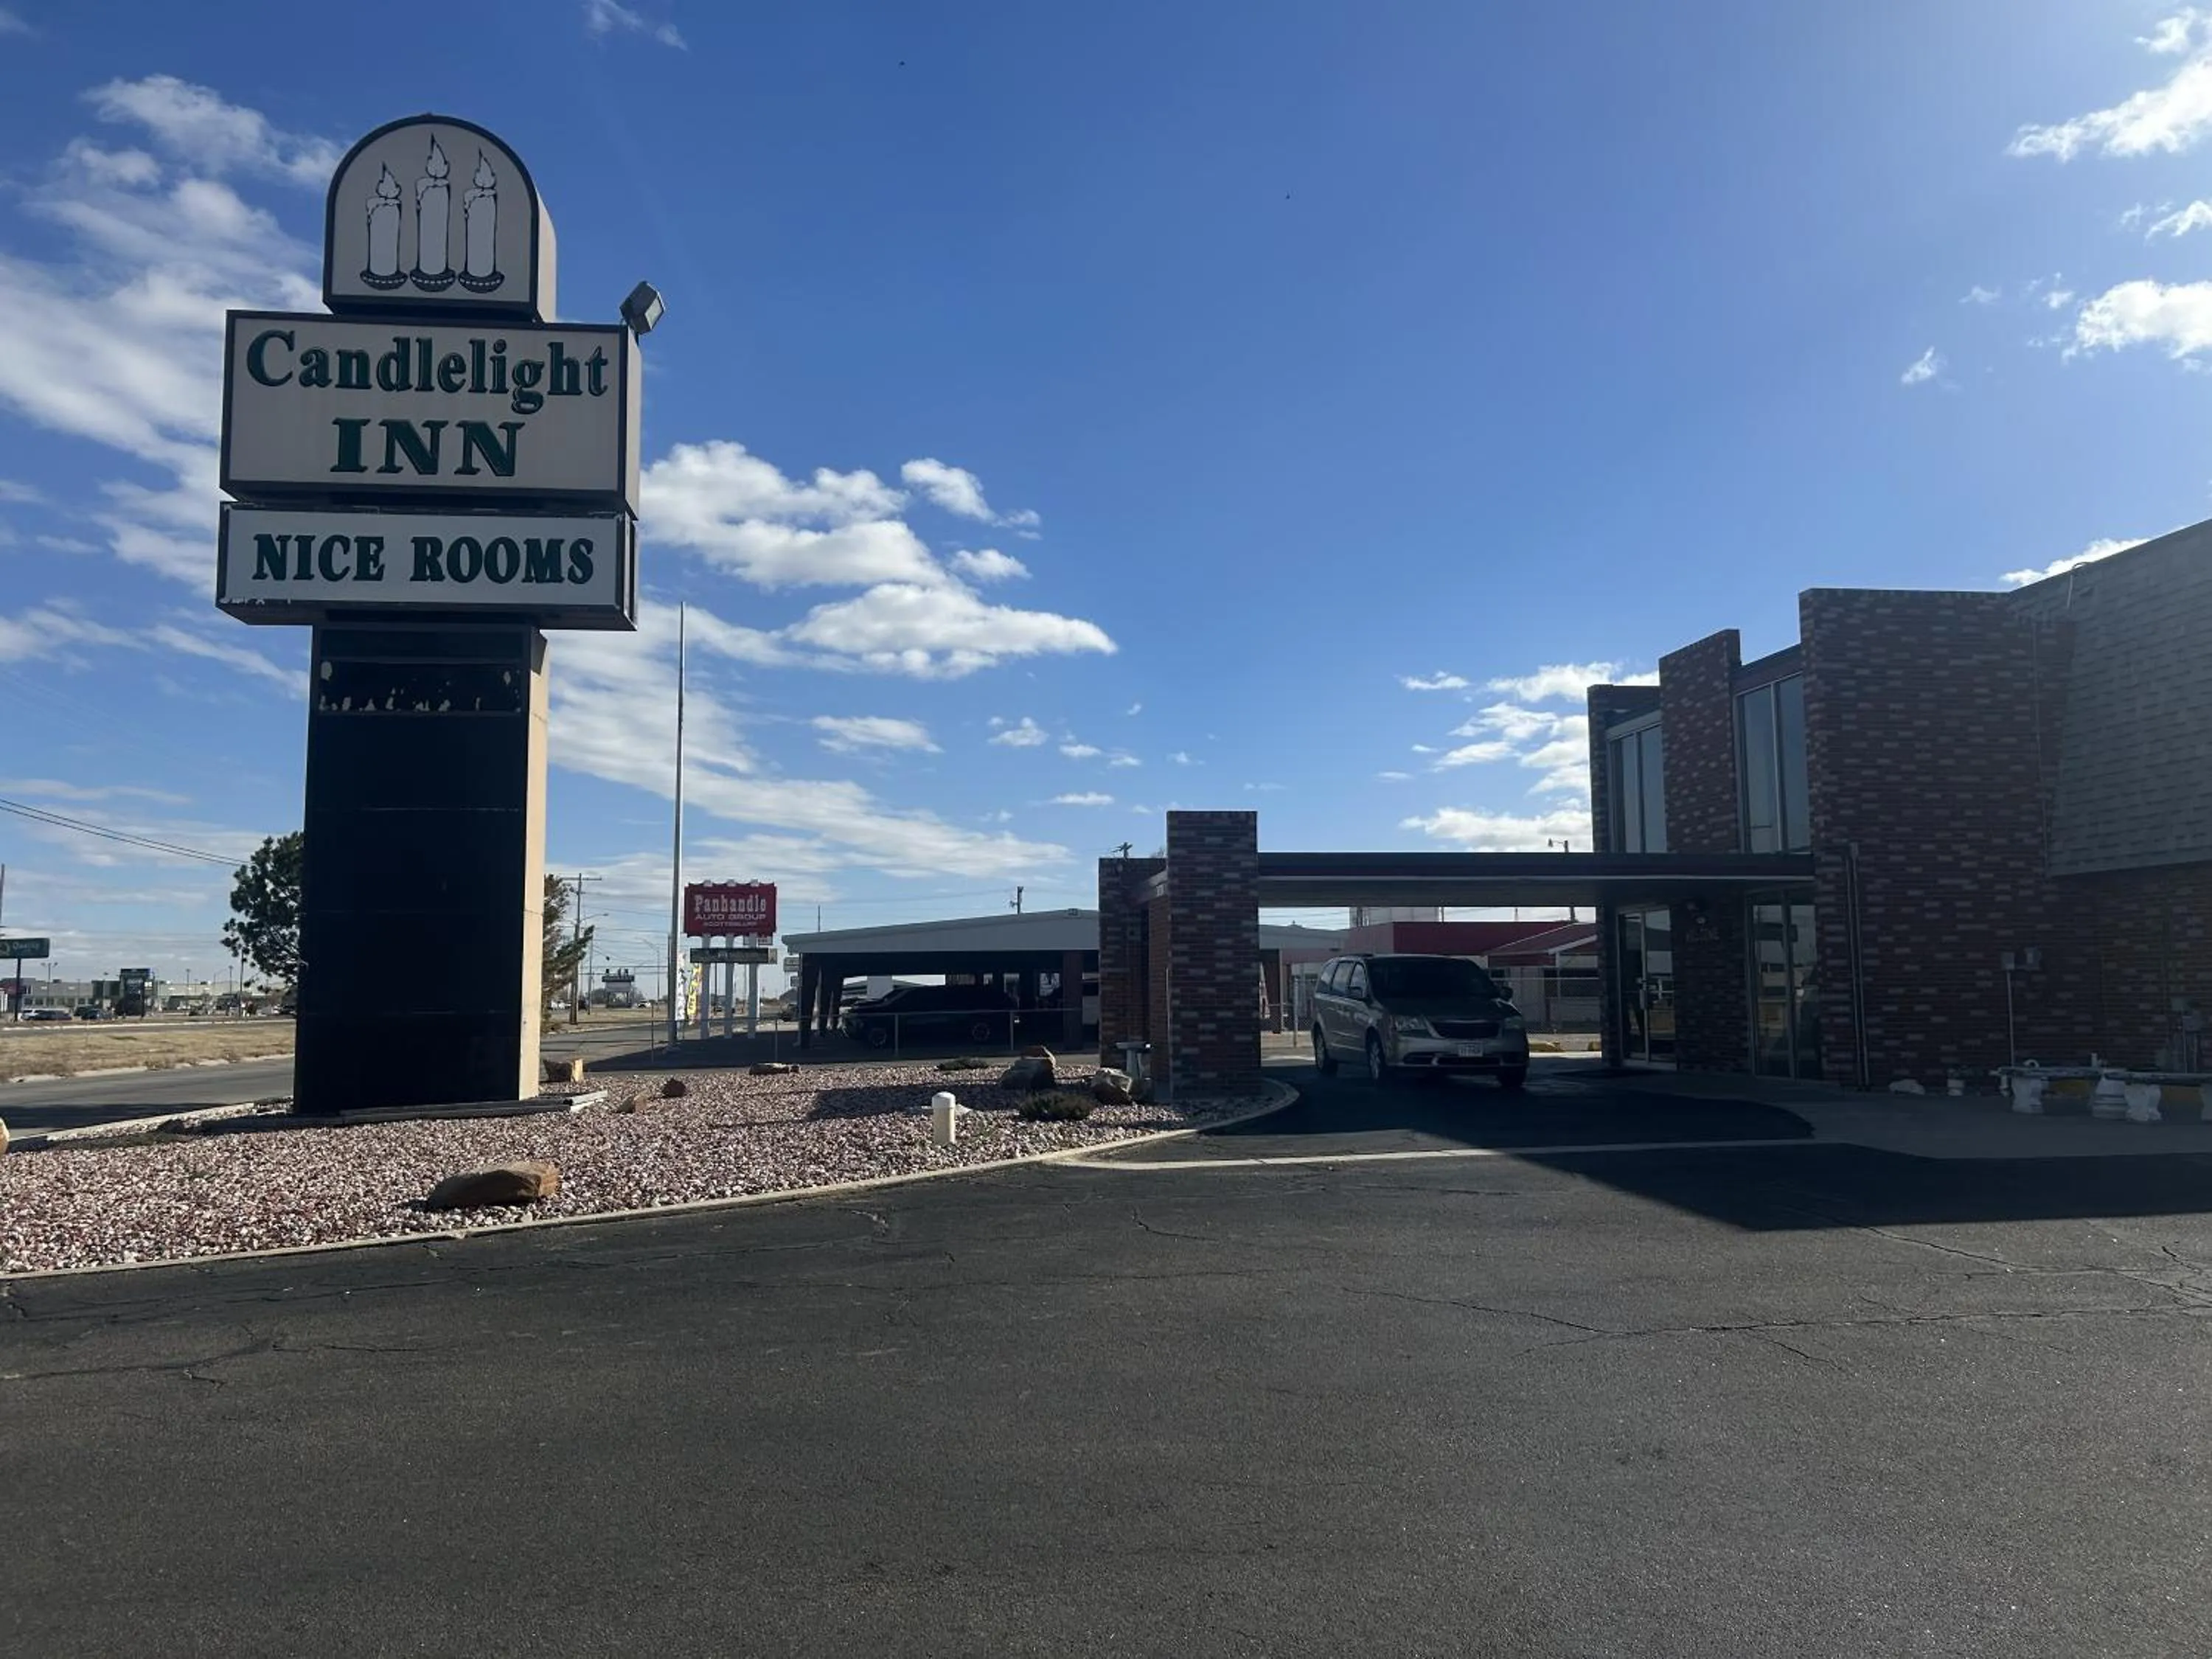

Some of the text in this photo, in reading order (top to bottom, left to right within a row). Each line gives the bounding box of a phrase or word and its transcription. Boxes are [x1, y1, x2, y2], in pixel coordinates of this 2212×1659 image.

[247, 330, 608, 414] Candlelight
[330, 418, 525, 477] INN
[252, 534, 594, 584] NICE ROOMS
[695, 894, 766, 912] Panhandle
